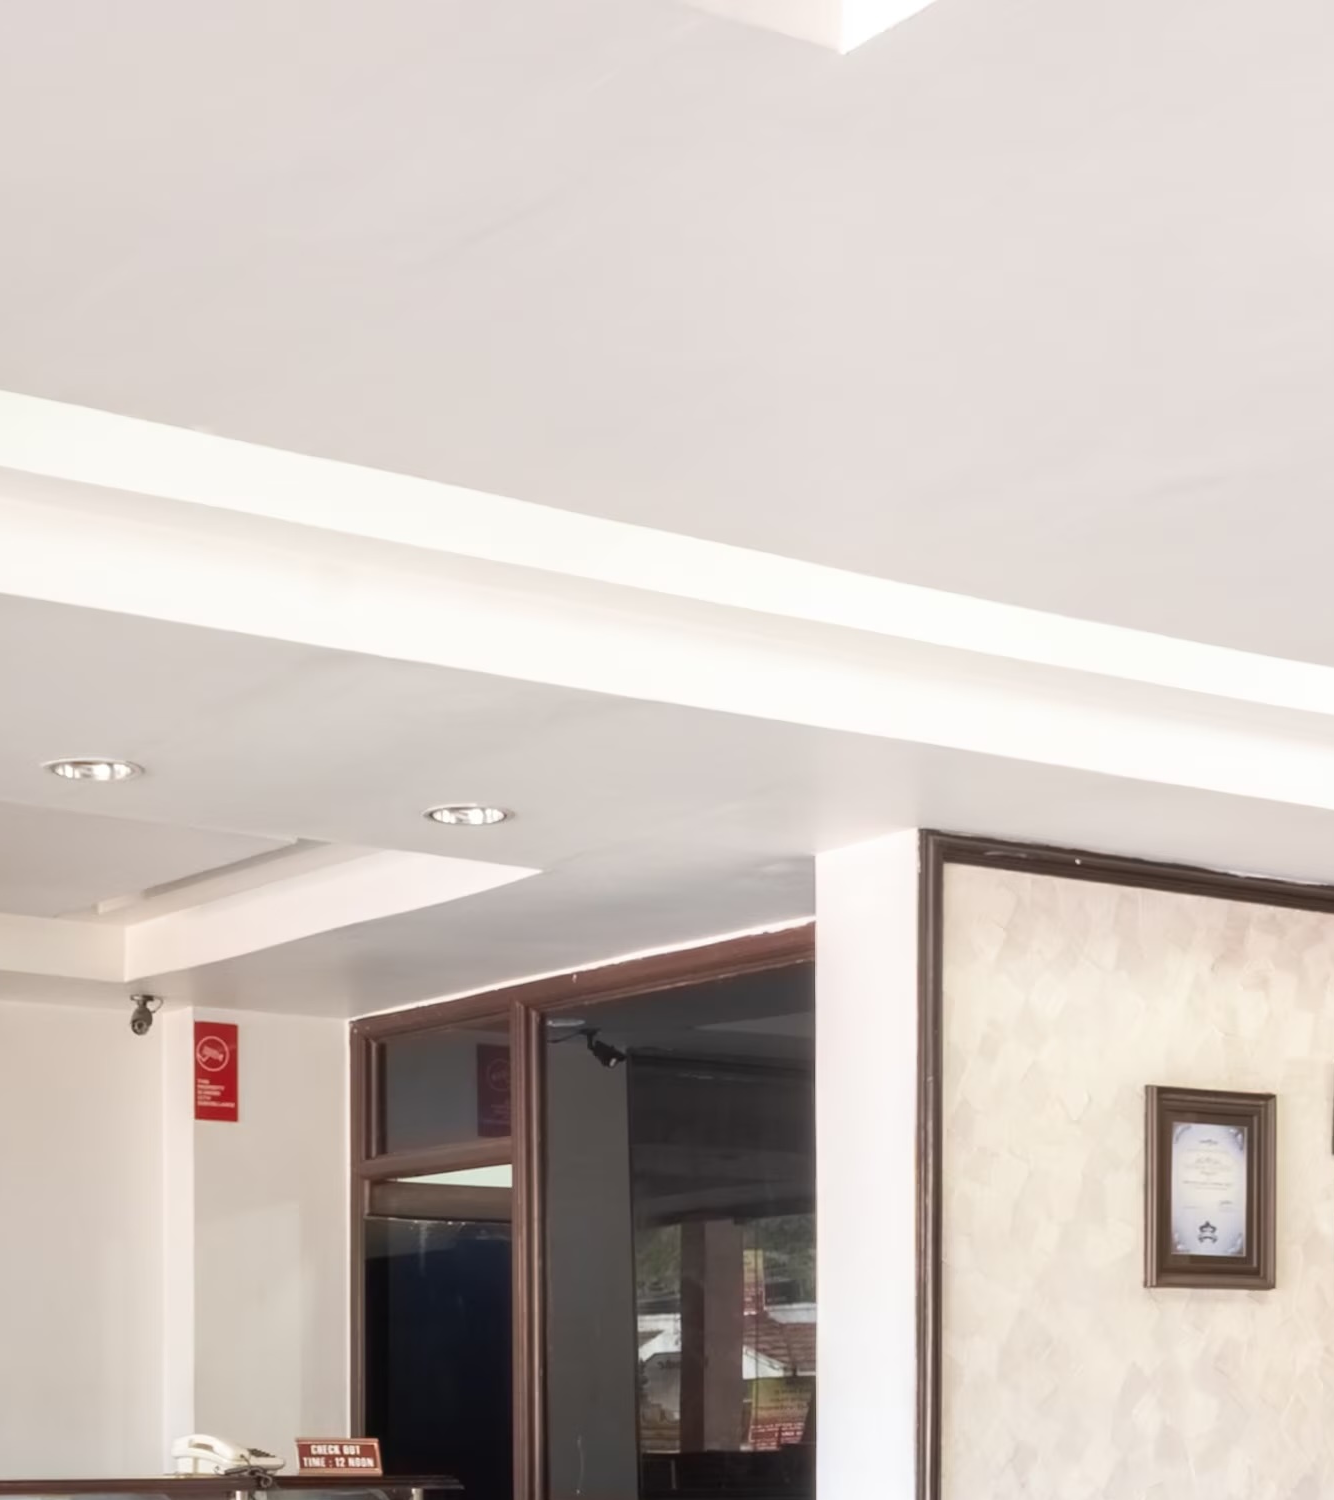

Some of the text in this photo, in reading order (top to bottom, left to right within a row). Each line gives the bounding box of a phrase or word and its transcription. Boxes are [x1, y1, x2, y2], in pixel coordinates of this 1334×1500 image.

[310, 1444, 361, 1456] CHECK OUT
[302, 1456, 326, 1468] TIME
[335, 1456, 345, 1468] 12
[347, 1456, 375, 1469] NOON
